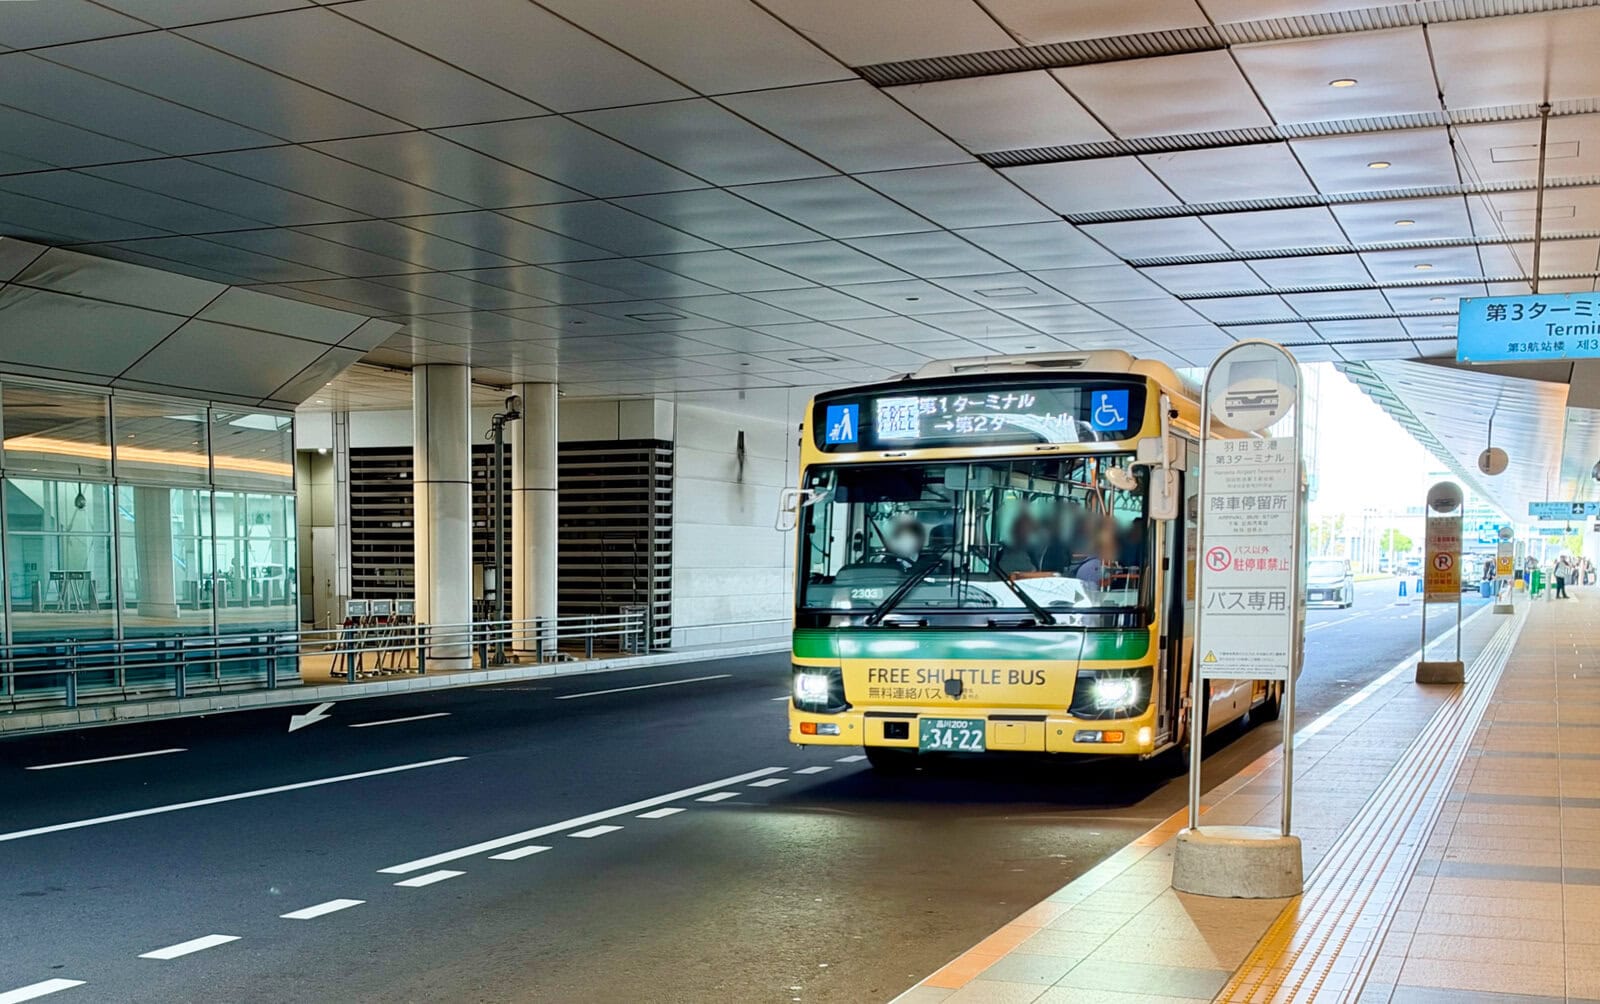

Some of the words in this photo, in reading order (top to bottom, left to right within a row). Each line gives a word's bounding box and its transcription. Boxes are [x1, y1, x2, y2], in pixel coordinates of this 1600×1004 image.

[1486, 300, 1600, 322] 第3ターミ
[919, 393, 1036, 415] 第1ターミナル
[955, 412, 1075, 434] 第2ターナル
[1223, 440, 1278, 452] 羽田空港
[1215, 453, 1285, 465] 第3ターミナル
[1210, 495, 1288, 511] 降車停留所
[1234, 545, 1269, 554] バス以外
[1233, 557, 1289, 572] 駐停車禁止
[1207, 591, 1286, 611] バス専用
[868, 668, 910, 683] FREE
[916, 668, 1001, 685] SHUTTLE
[1008, 669, 1046, 685] BUS
[868, 687, 942, 699] 無料連絡バス
[930, 728, 983, 749] 34-22
